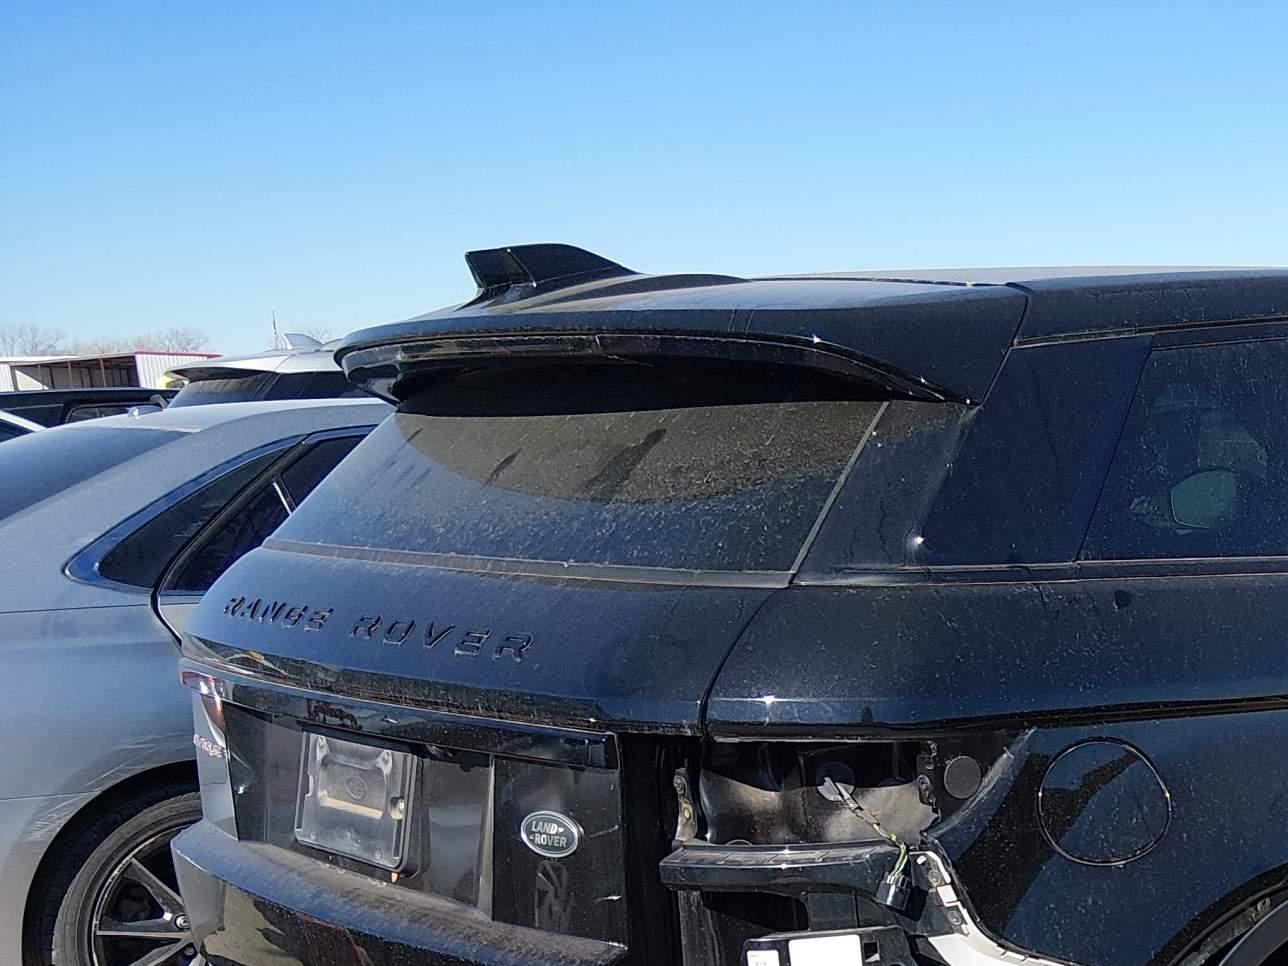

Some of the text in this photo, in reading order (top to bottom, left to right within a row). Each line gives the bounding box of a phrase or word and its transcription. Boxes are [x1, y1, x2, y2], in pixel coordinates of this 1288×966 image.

[222, 596, 536, 663] RANGE ROVER
[531, 820, 559, 835] LAND
[534, 833, 568, 848] ROVER
